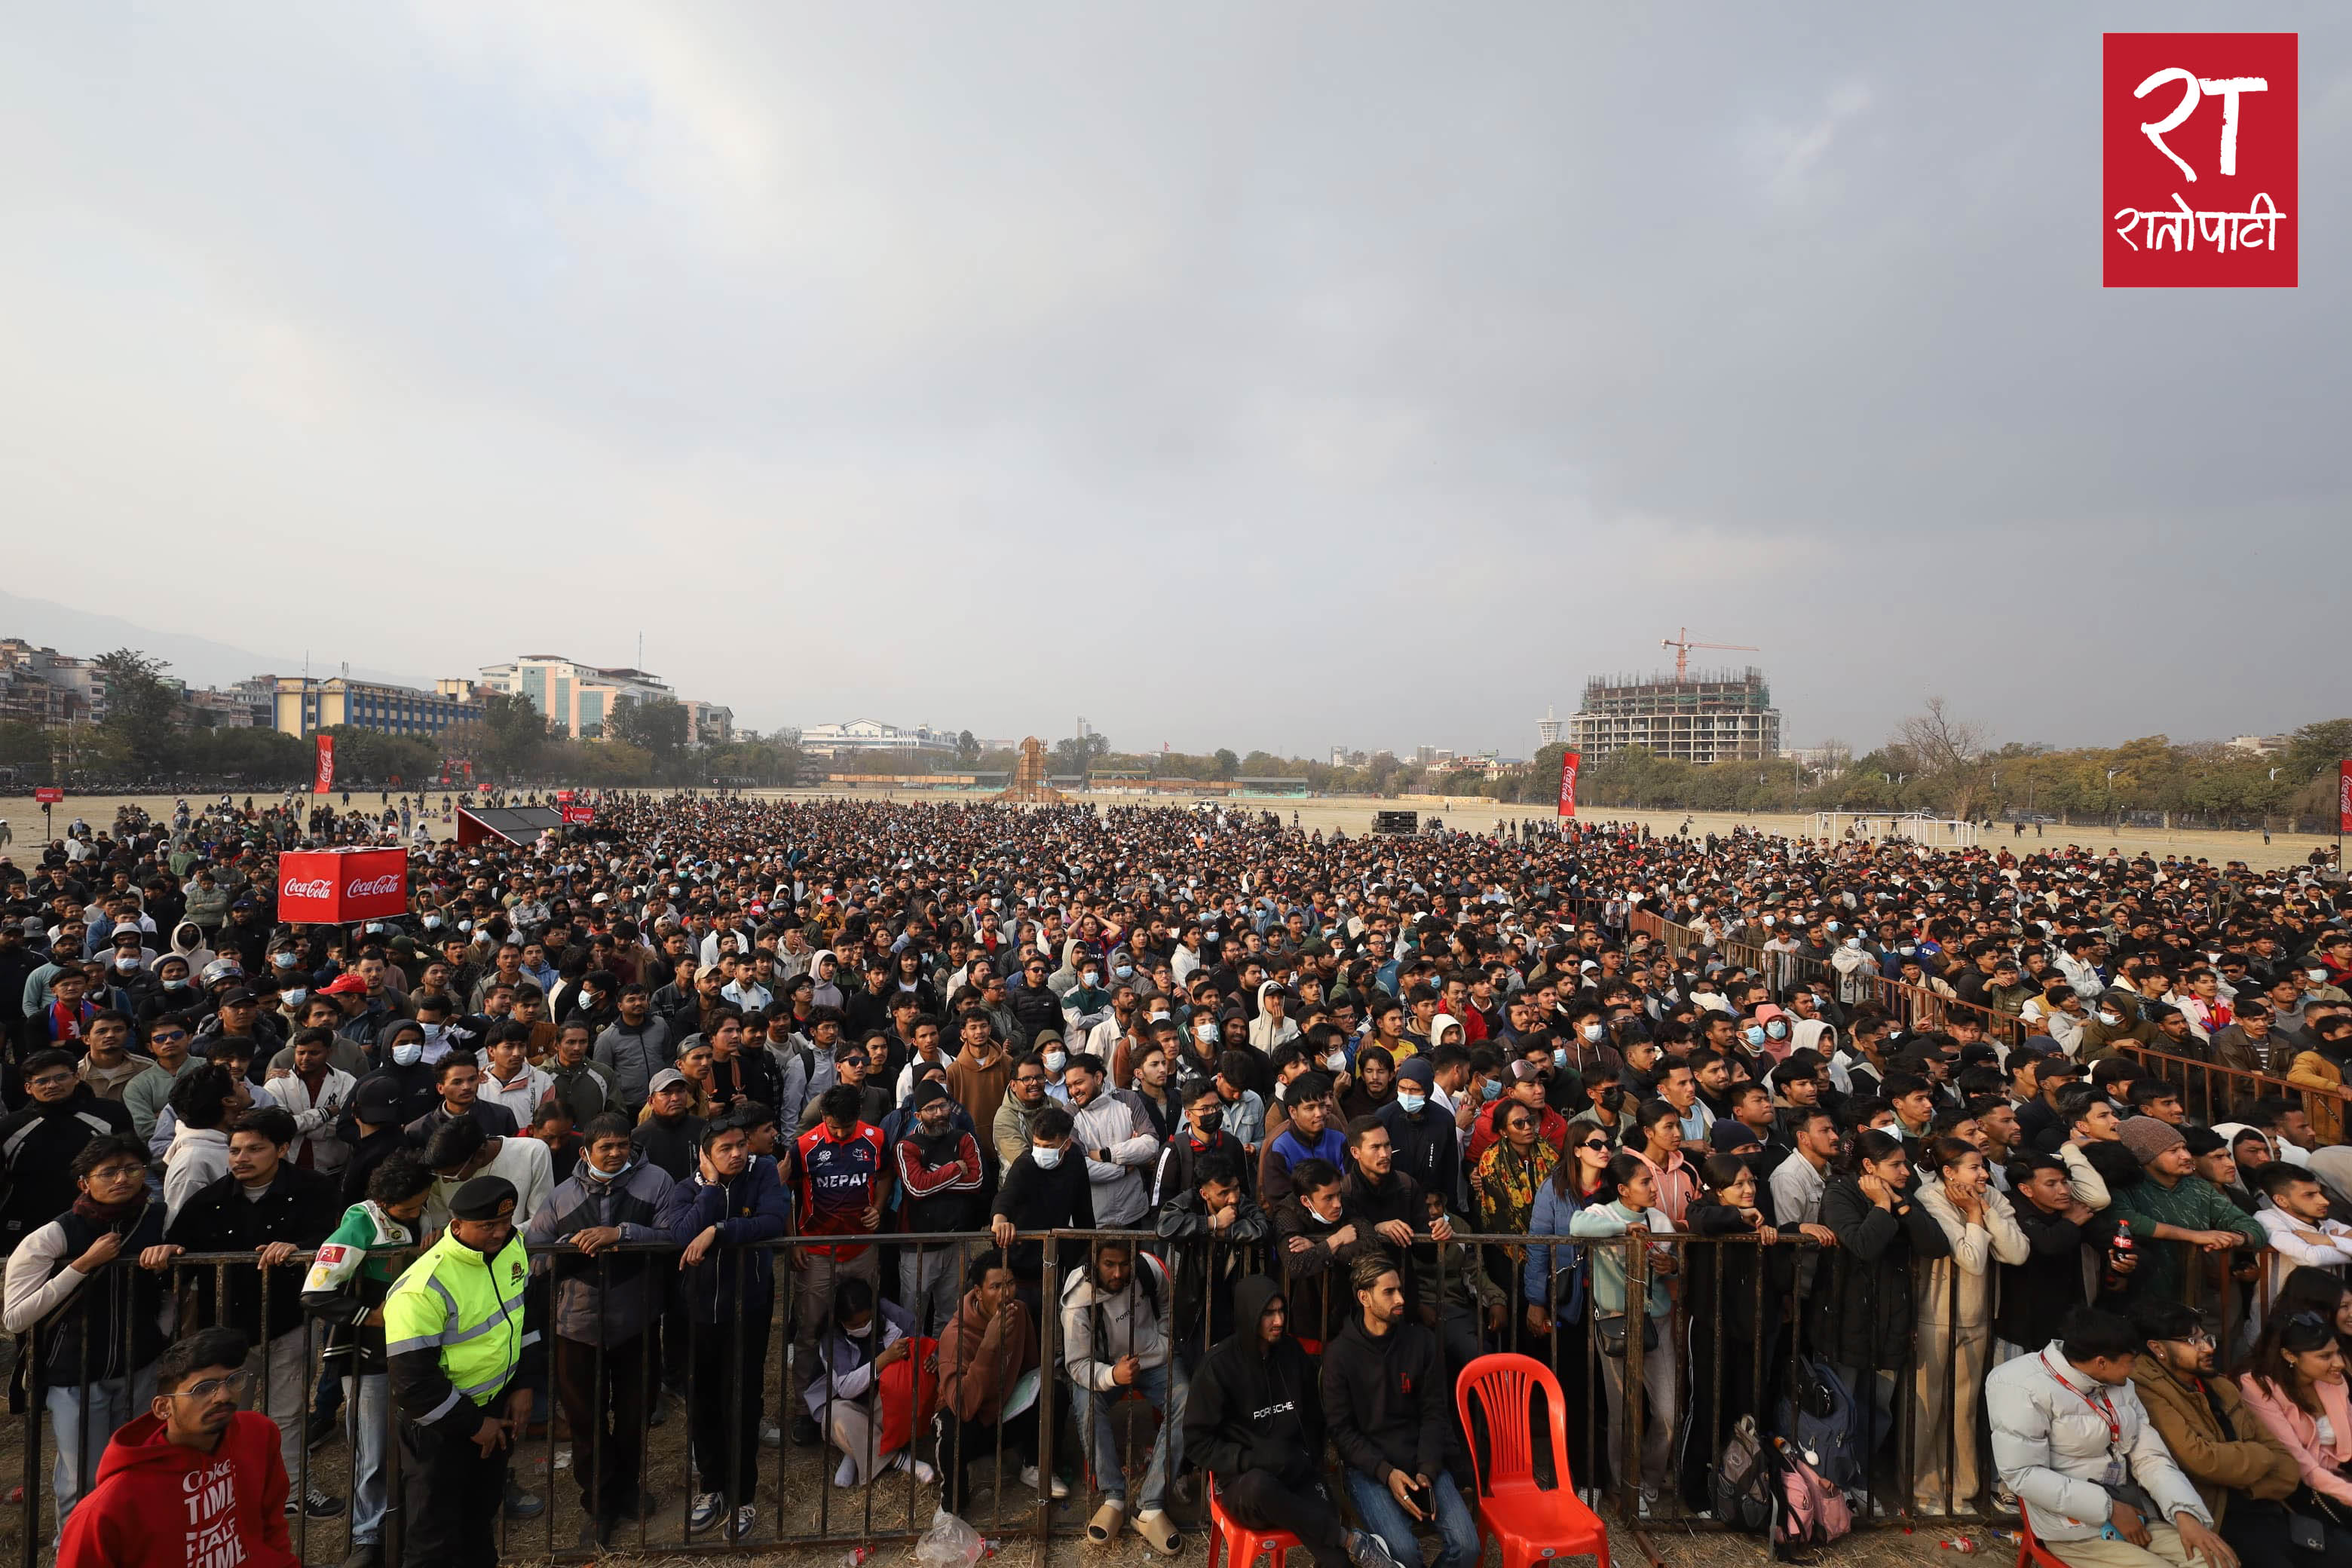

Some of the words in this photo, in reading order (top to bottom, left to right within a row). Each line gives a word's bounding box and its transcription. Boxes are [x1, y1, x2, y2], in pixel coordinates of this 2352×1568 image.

[284, 877, 333, 899] Coca-Cola
[347, 874, 401, 899] Coca-Cola
[1254, 1401, 1294, 1420] PORSCHE
[182, 1459, 231, 1493] Coke
